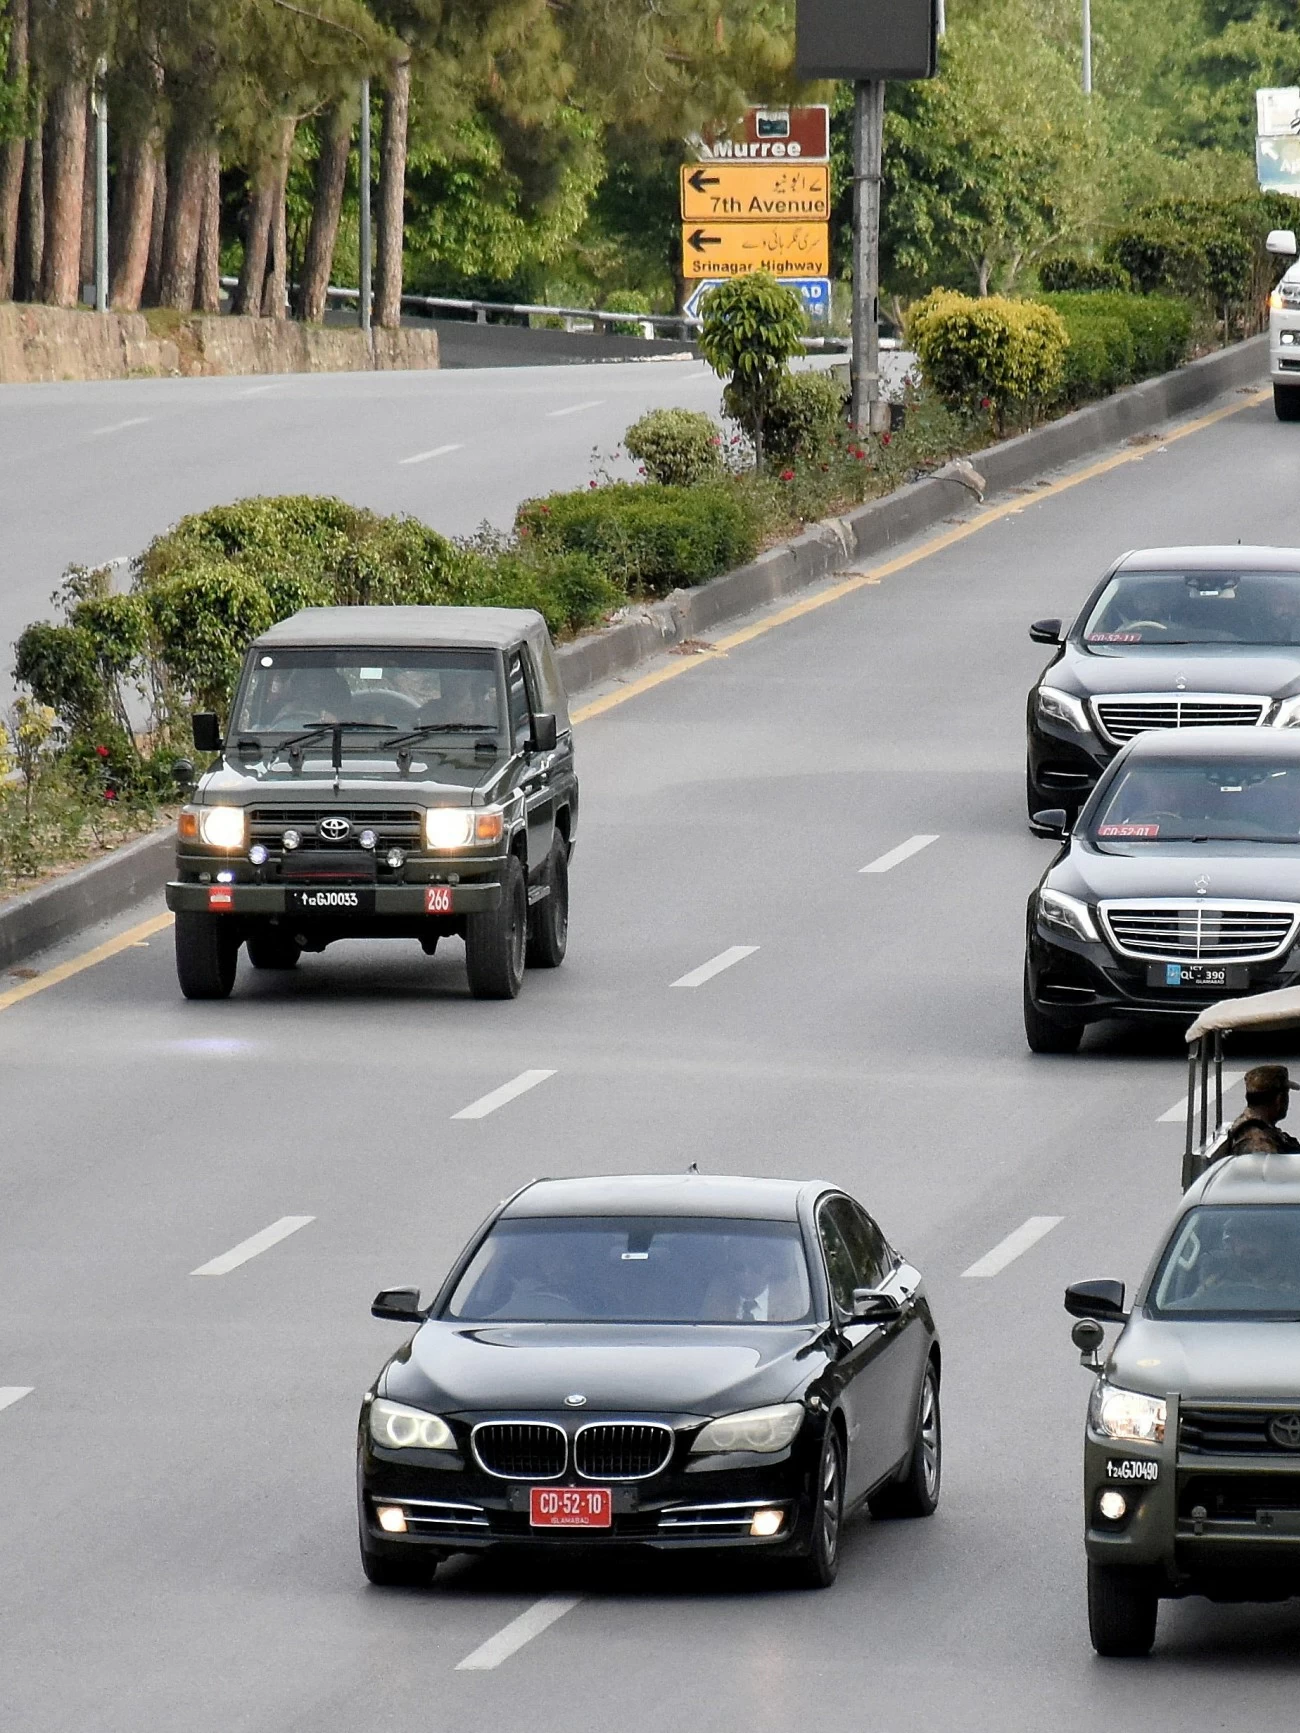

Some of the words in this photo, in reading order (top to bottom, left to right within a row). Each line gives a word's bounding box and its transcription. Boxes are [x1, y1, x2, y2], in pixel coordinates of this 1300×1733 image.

[713, 140, 801, 157] Murree
[710, 197, 741, 213] 7th
[748, 196, 825, 213] Avenue
[692, 260, 753, 274] Srinagar
[761, 260, 823, 274] Highway
[428, 889, 449, 911] 266
[1180, 970, 1195, 981] QL
[1205, 971, 1225, 980] 390
